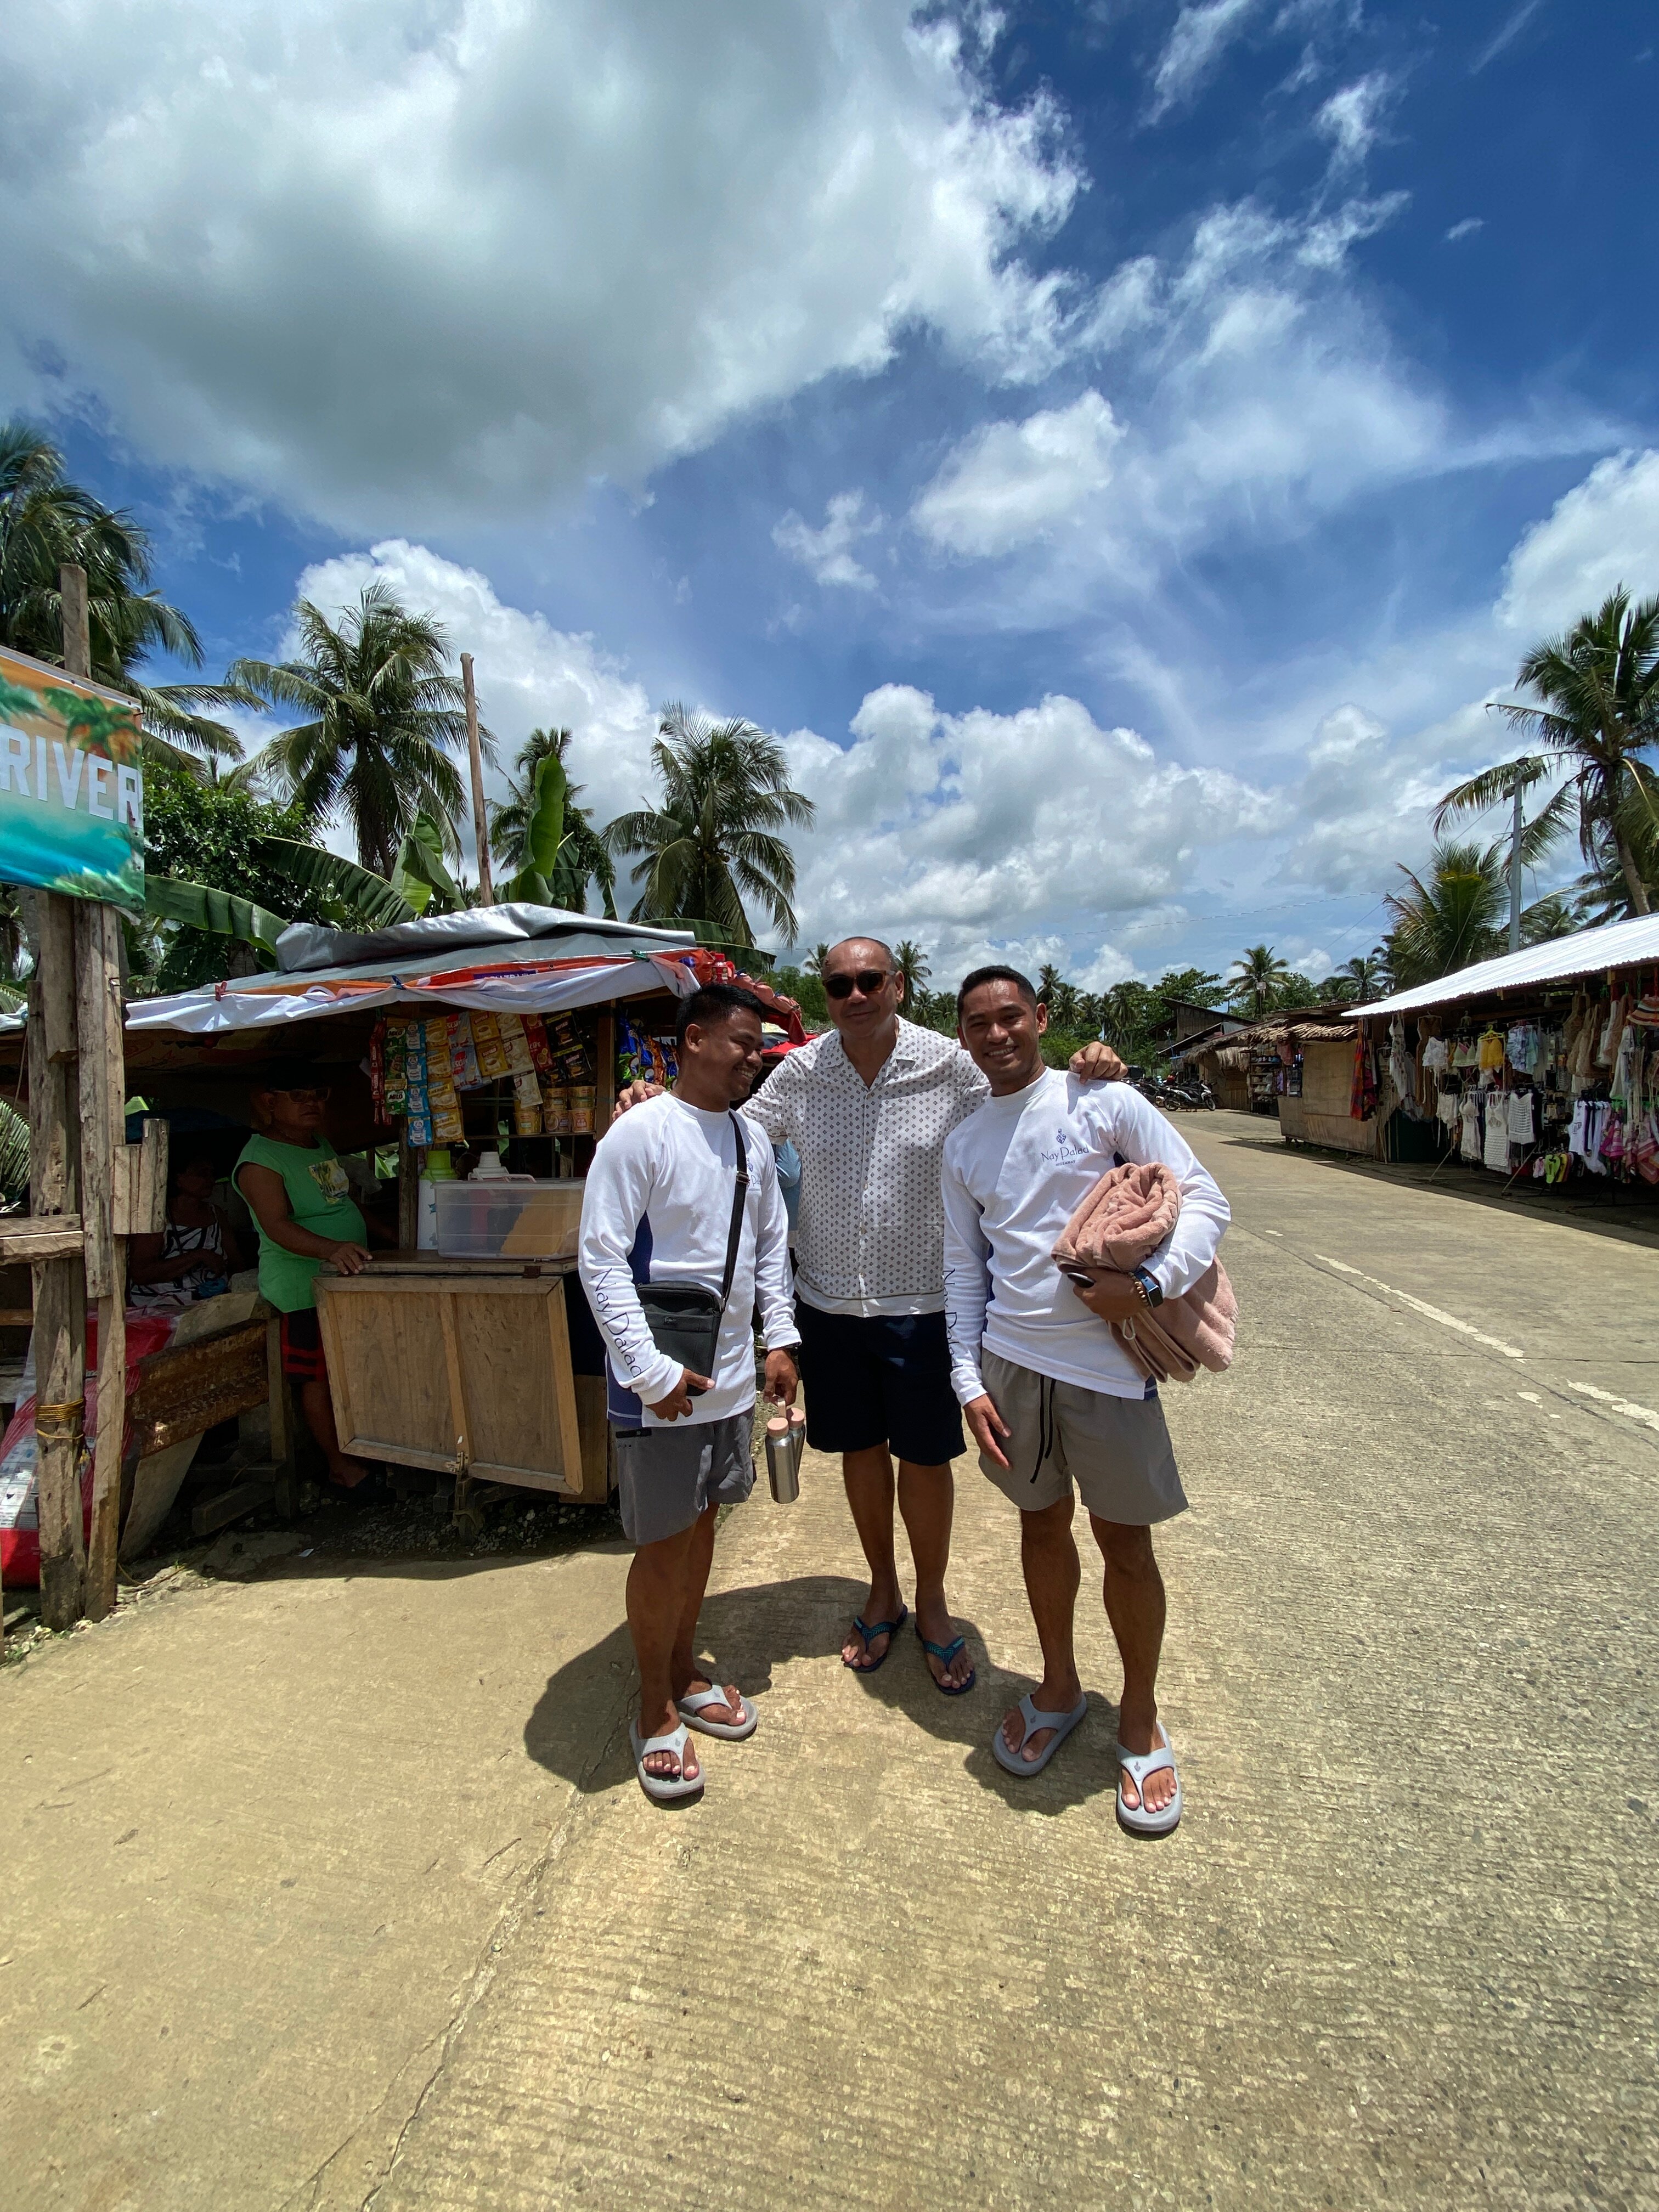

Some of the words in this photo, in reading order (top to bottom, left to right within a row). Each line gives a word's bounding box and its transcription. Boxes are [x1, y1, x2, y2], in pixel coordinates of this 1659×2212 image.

[0, 723, 143, 830] RIVER
[1041, 1150, 1059, 1163] Nay
[1060, 1144, 1090, 1161] Palad
[591, 1267, 617, 1313] Nay
[602, 1312, 654, 1379] Palad
